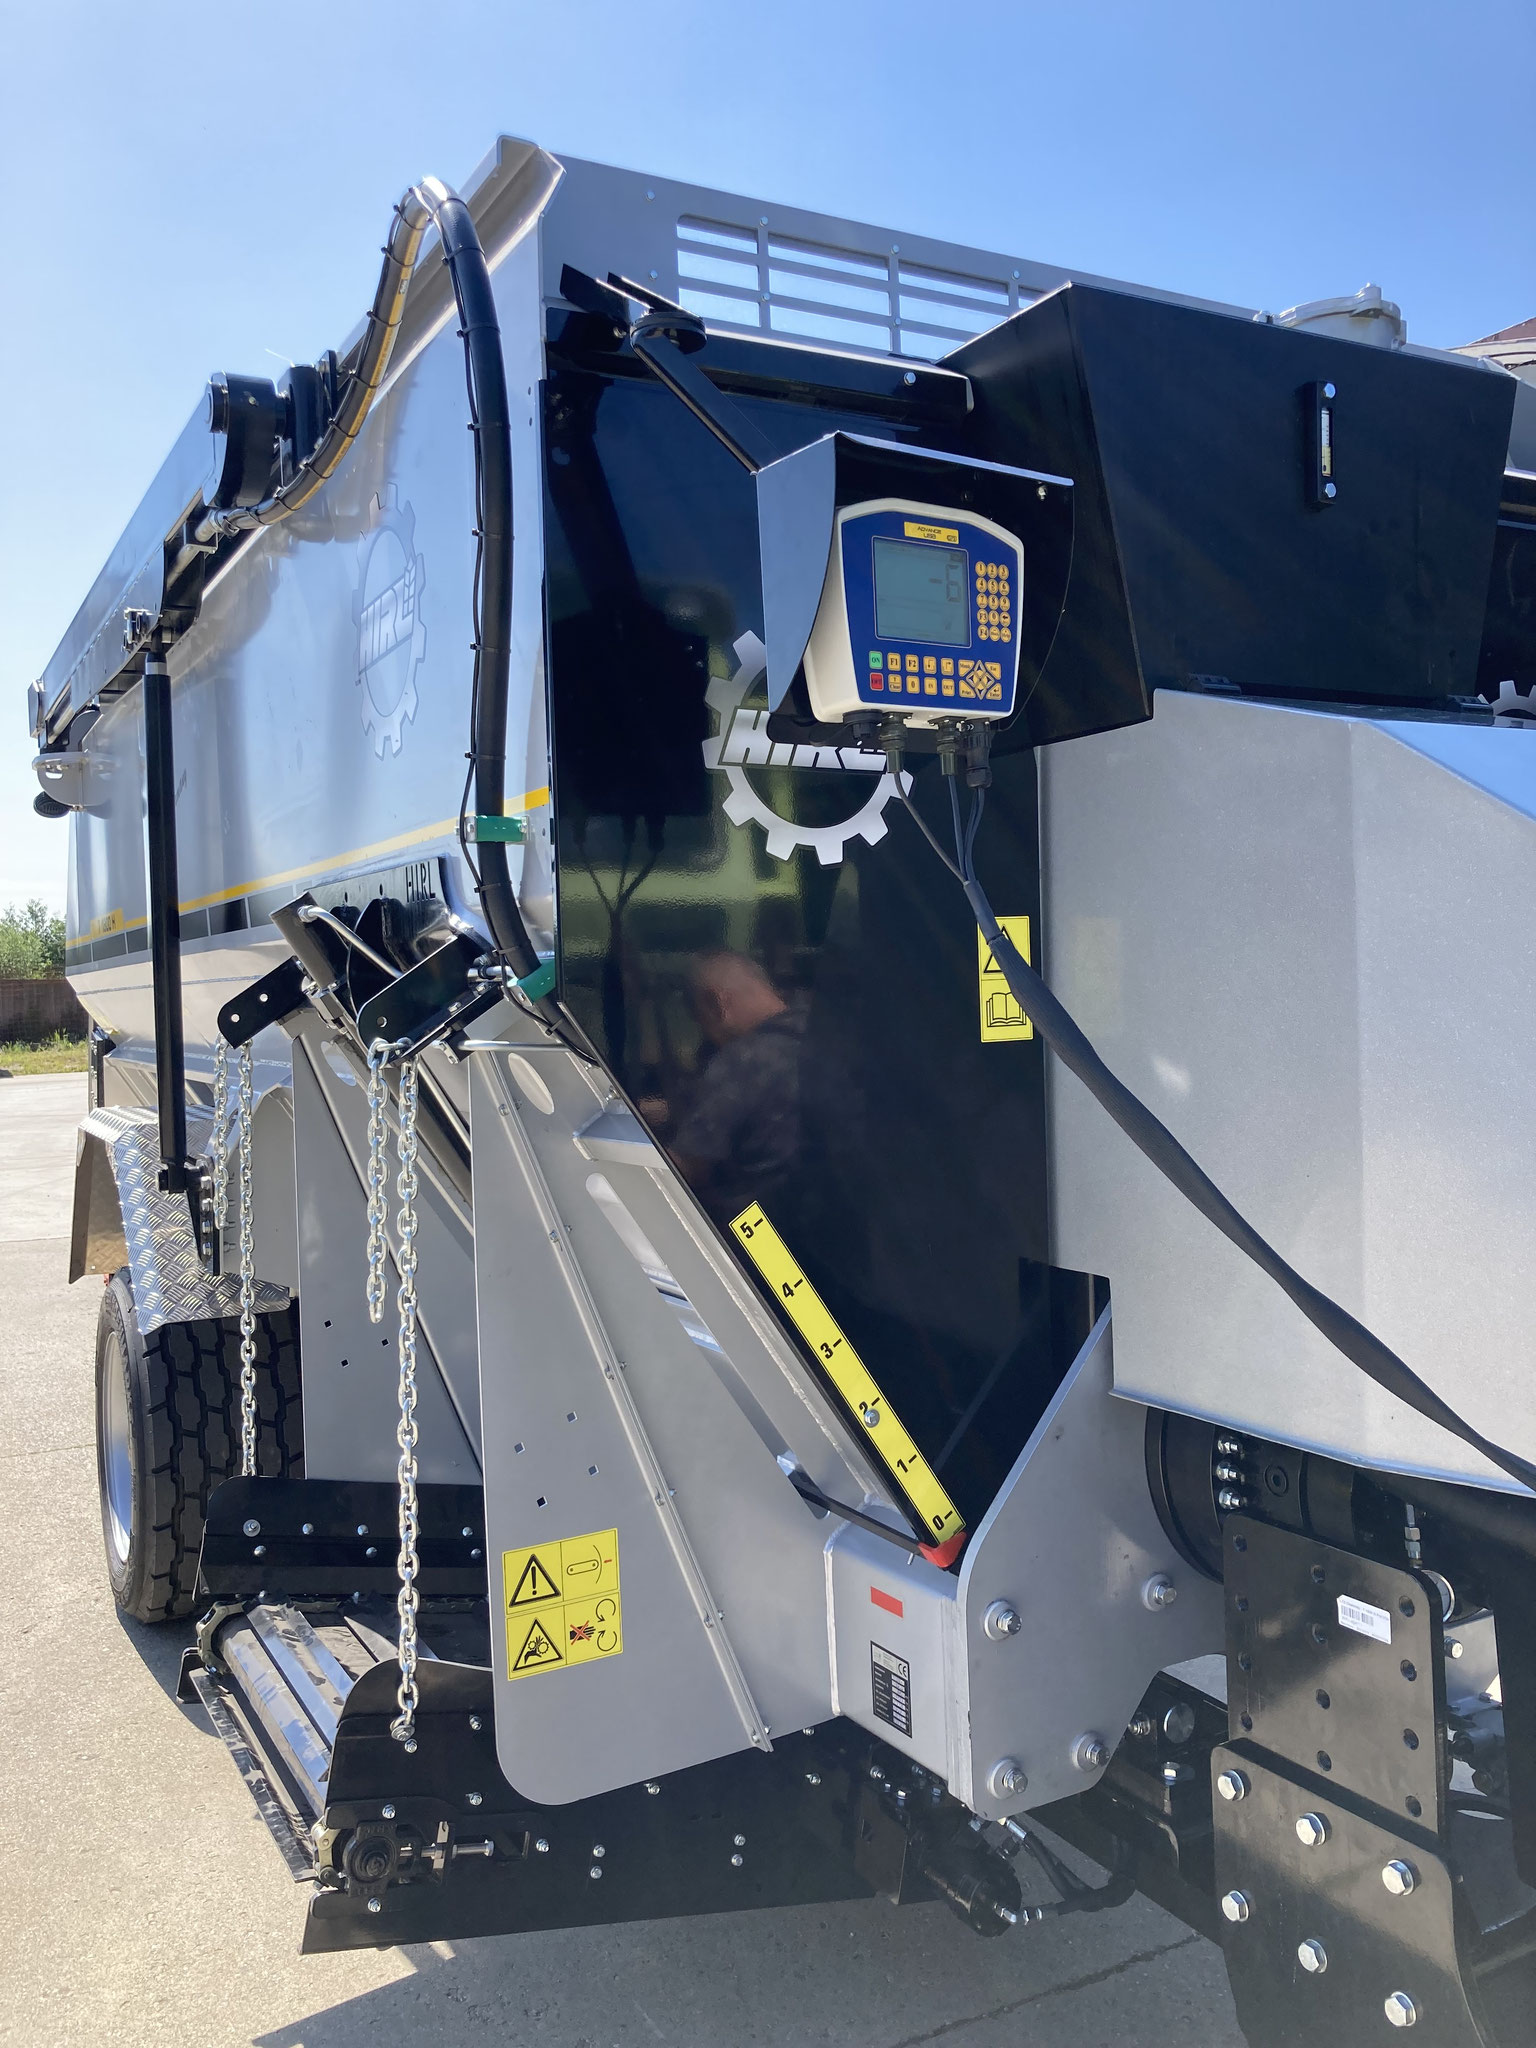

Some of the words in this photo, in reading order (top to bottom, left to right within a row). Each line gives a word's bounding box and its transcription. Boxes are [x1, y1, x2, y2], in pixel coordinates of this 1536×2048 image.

[917, 526, 942, 534] ADVANCE
[890, 658, 898, 666] F1
[908, 659, 917, 667] F2
[405, 861, 436, 902] HIRL
[740, 1221, 755, 1239] 5
[781, 1281, 795, 1298] 4
[820, 1342, 834, 1359] 3
[896, 1458, 909, 1473] 1
[932, 1514, 945, 1531] 0
